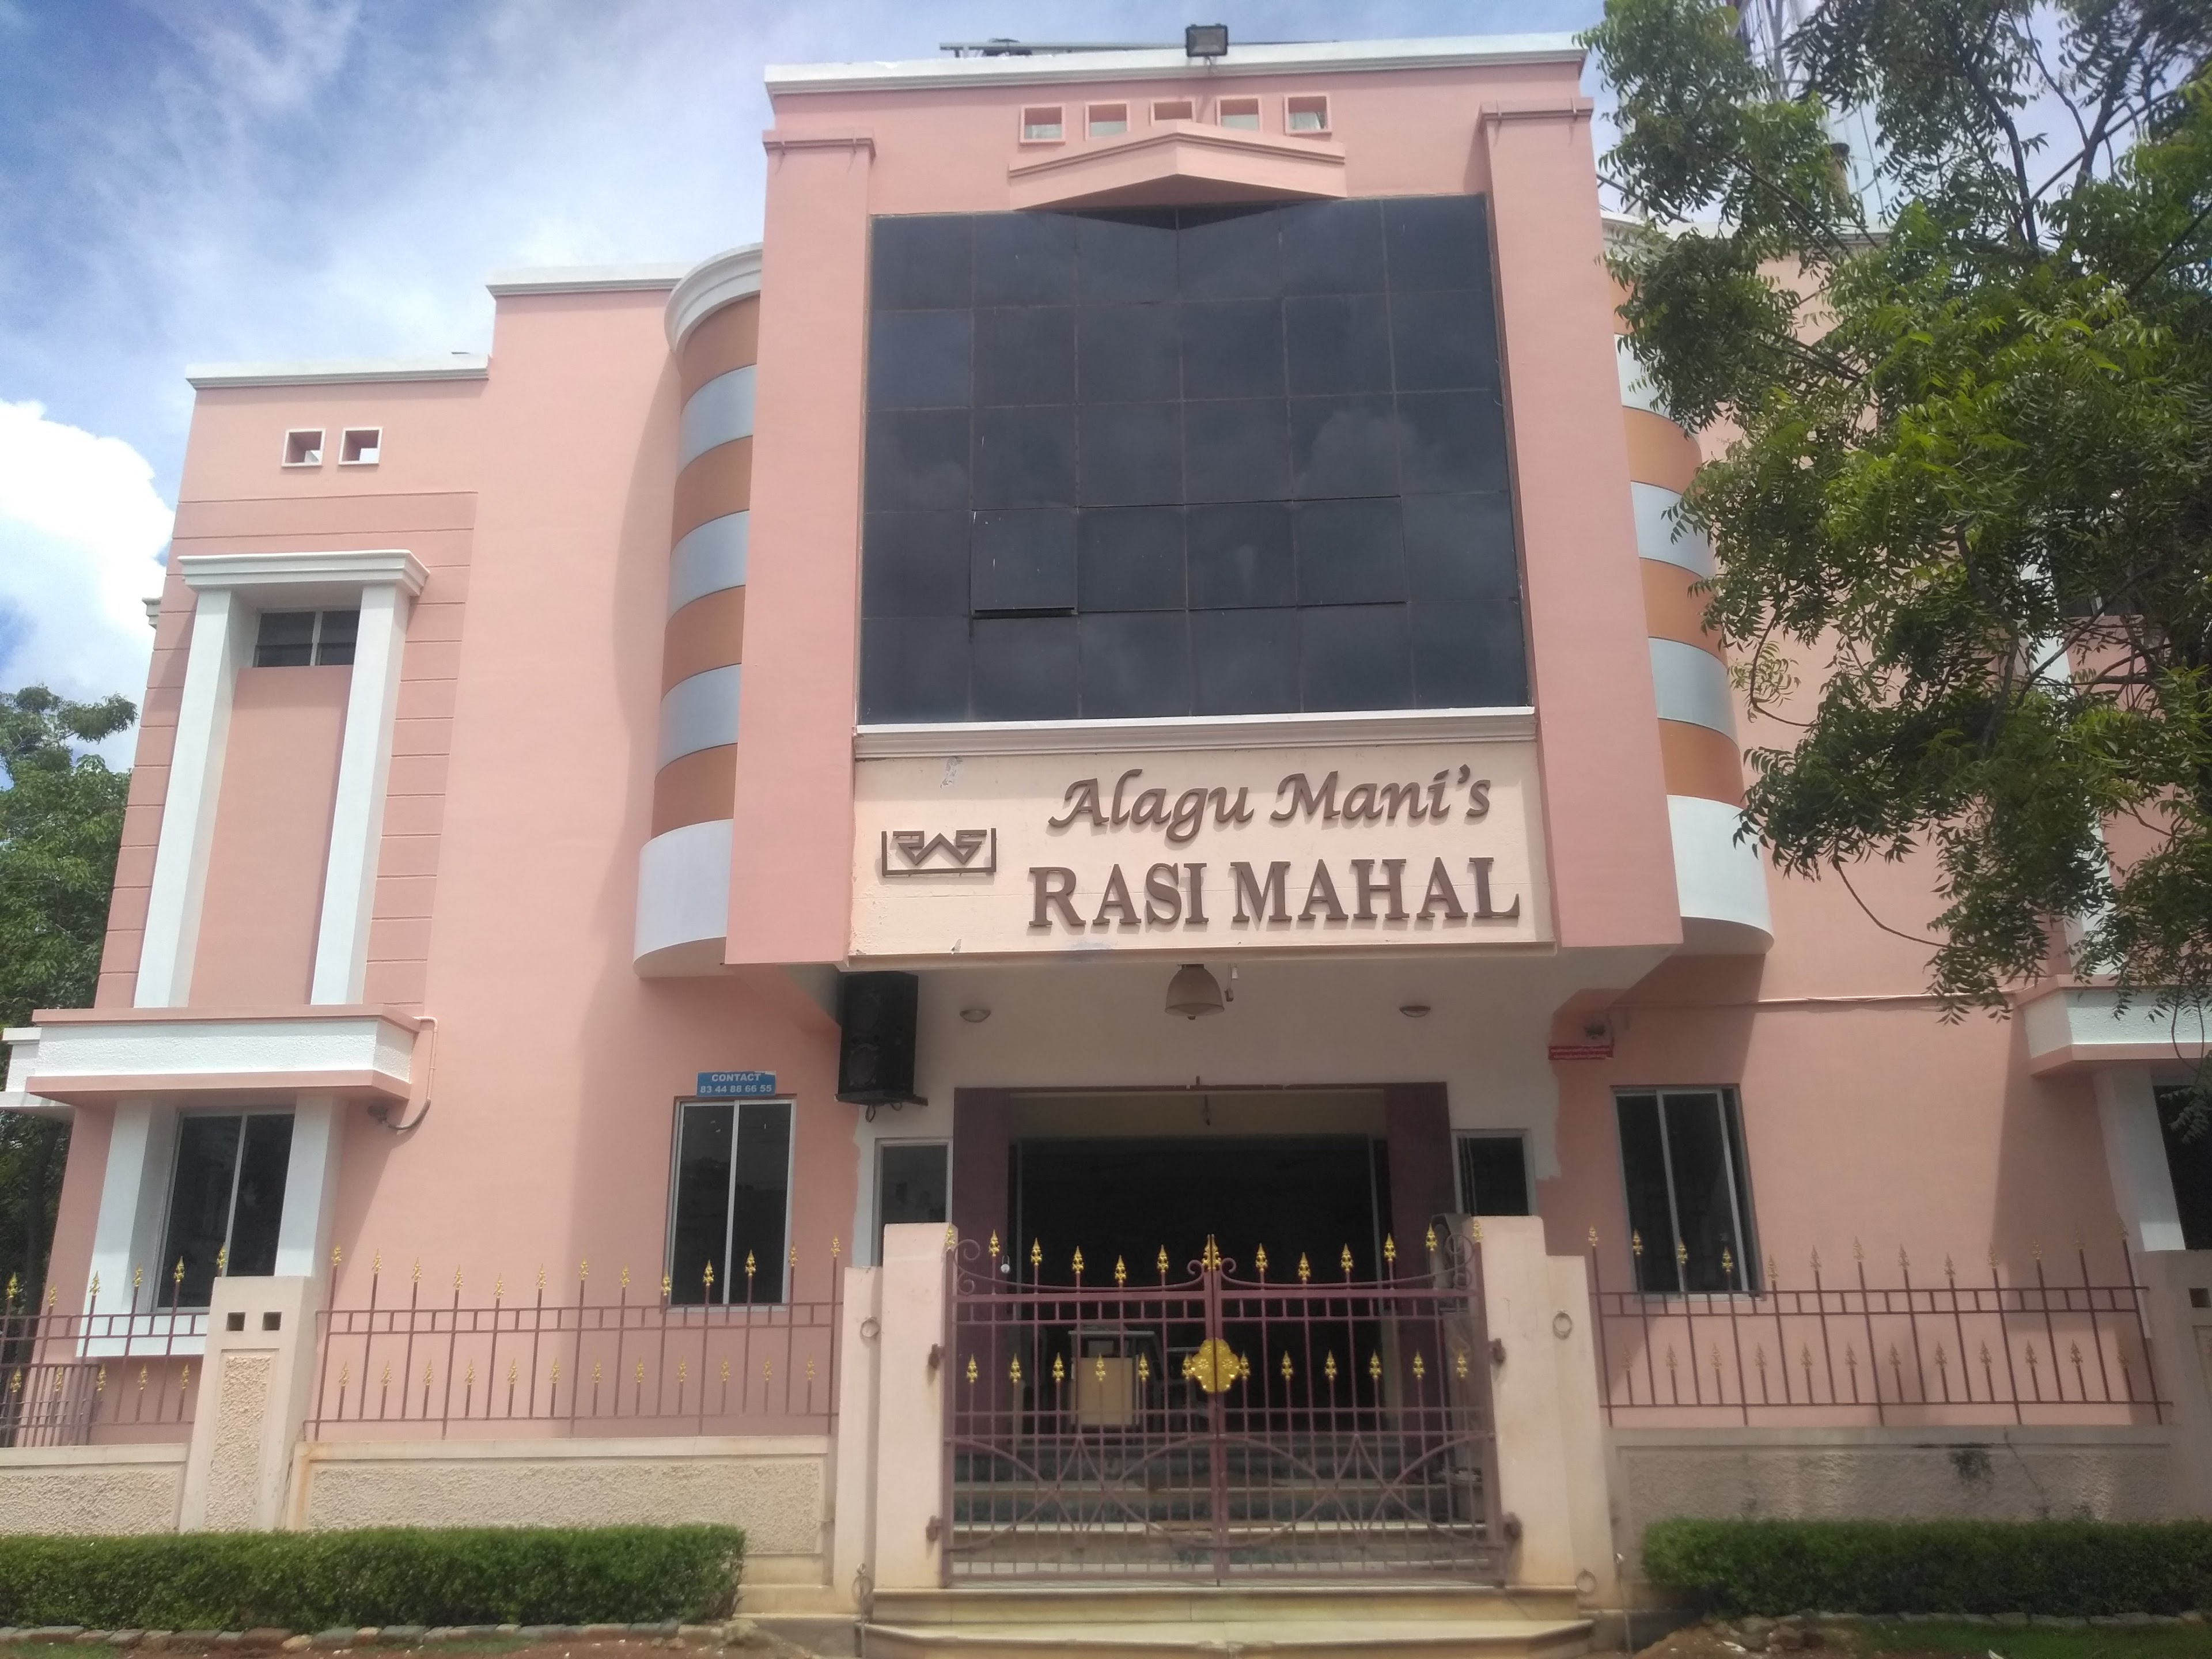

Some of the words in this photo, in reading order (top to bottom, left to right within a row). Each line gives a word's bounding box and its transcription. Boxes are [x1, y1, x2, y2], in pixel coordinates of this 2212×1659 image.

[1048, 768, 1255, 842] Alagu
[1270, 763, 1491, 820] Mani's
[1029, 862, 1210, 926] RASI
[1230, 856, 1521, 923] MAHAL
[700, 1085, 712, 1093] 83
[730, 1085, 742, 1093] 88
[760, 1084, 772, 1092] 55
[711, 1073, 761, 1082] CONTACT
